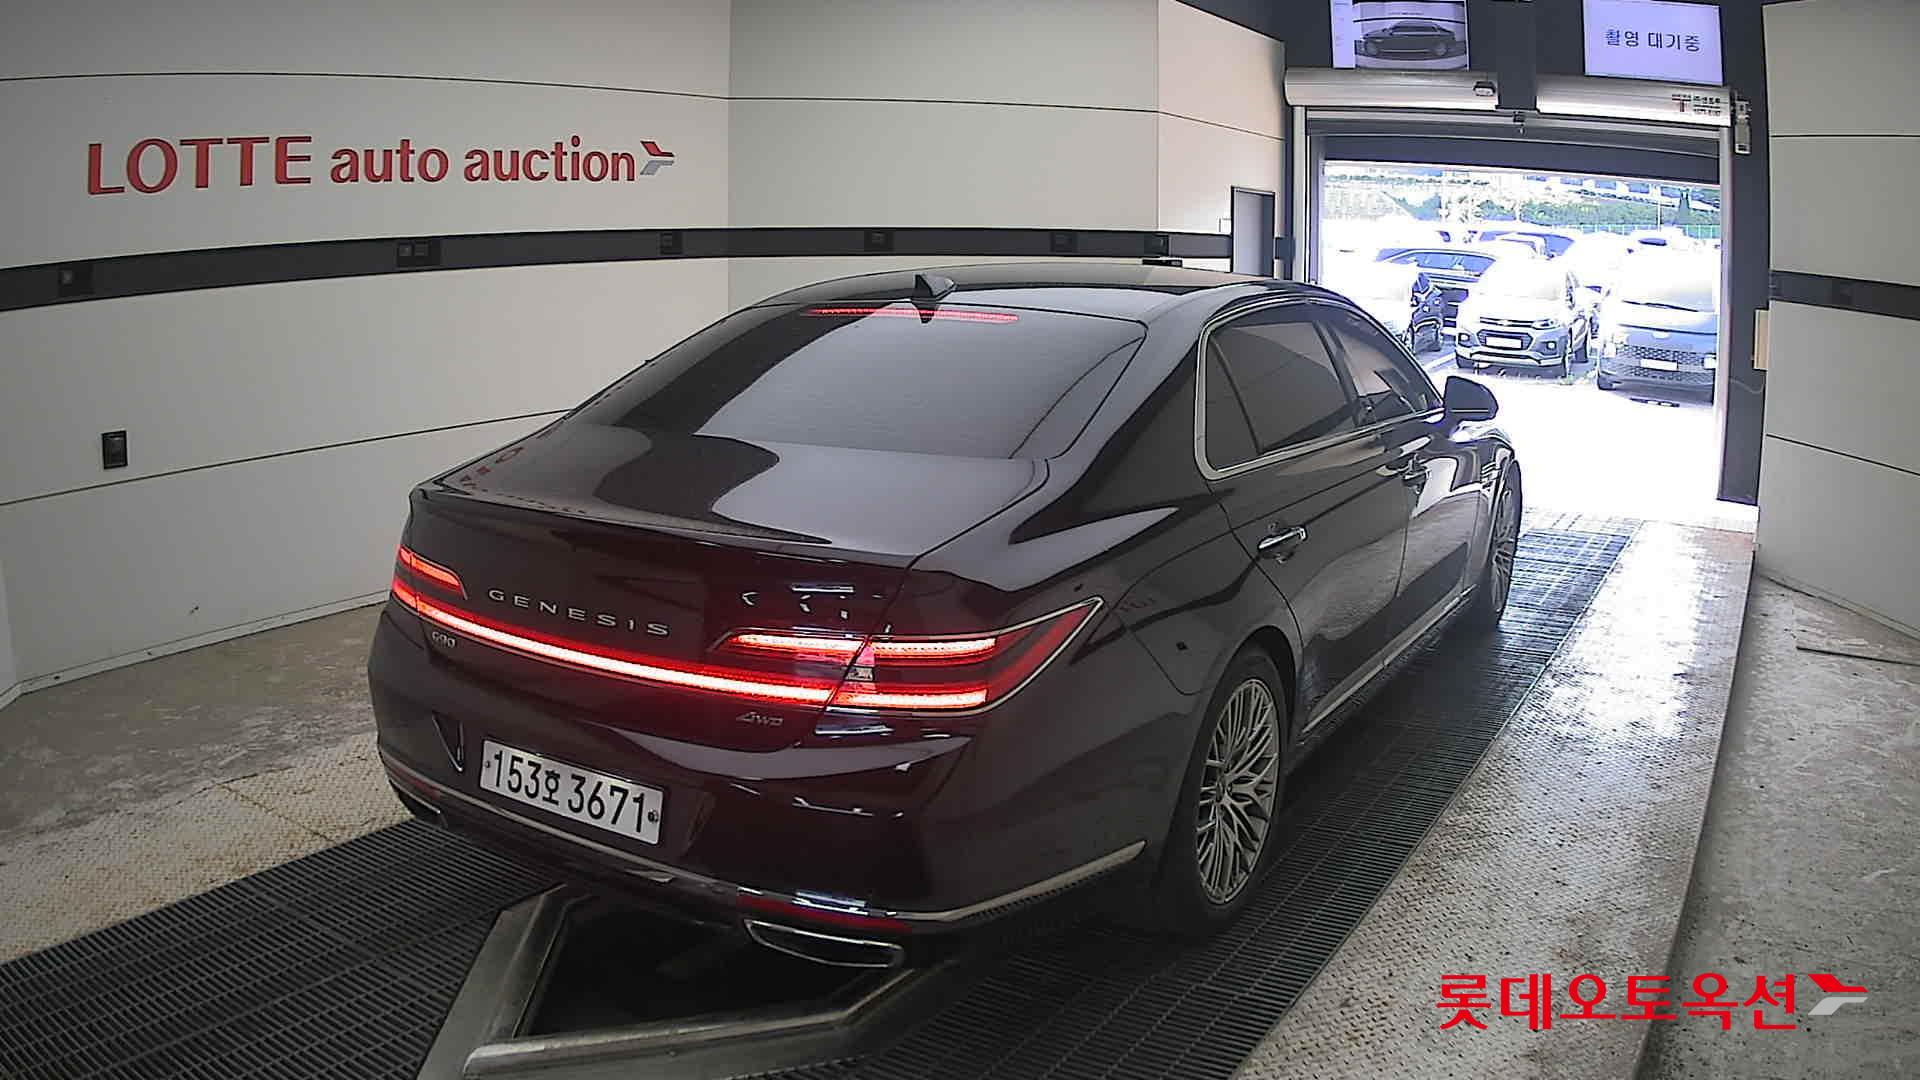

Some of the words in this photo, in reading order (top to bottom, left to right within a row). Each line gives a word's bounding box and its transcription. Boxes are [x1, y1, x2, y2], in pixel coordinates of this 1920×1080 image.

[1648, 31, 1701, 52] 대기중
[87, 135, 313, 196] LOTTE
[330, 138, 450, 184] auto
[463, 135, 637, 183] auction
[488, 589, 670, 636] GENESIS
[494, 750, 561, 806] 153호
[567, 773, 646, 833] 3671
